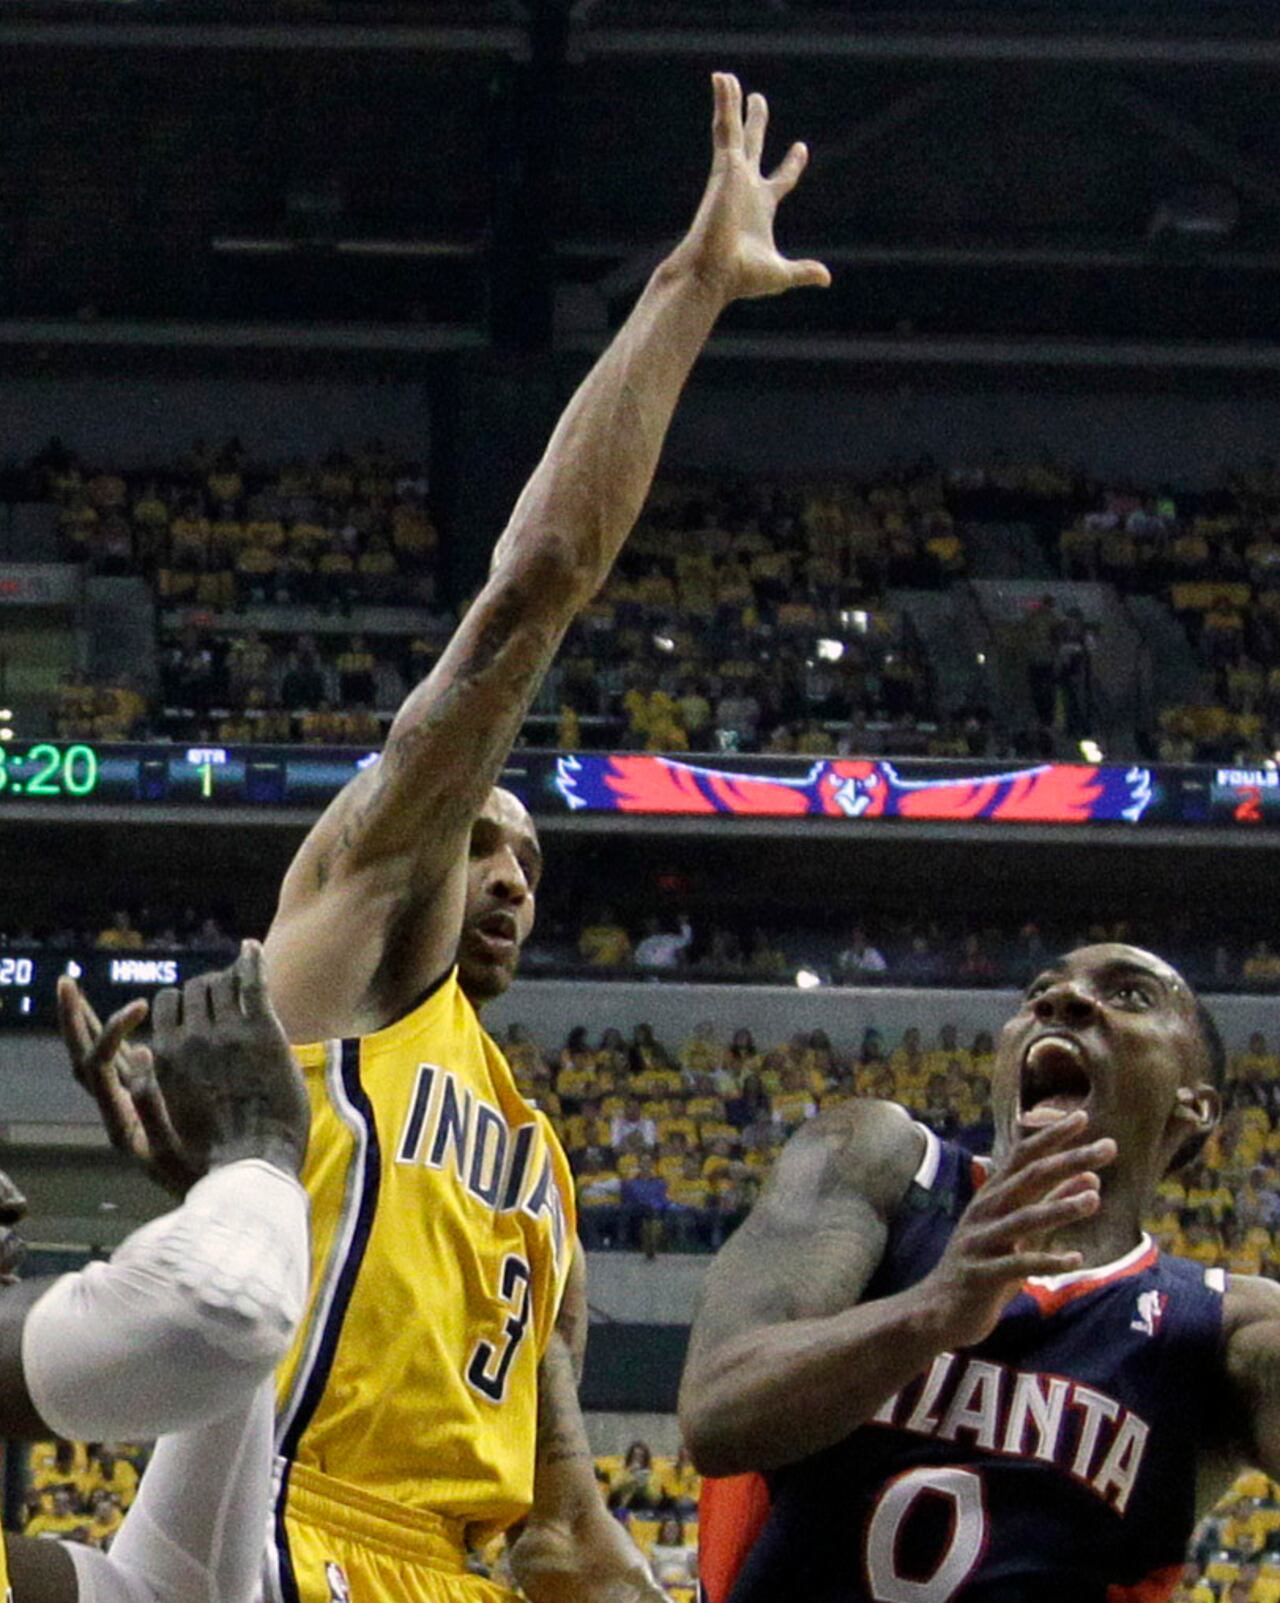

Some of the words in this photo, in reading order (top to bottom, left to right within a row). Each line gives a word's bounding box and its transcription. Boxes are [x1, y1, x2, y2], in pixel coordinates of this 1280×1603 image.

[197, 764, 212, 798] 1
[1217, 769, 1280, 786] FOULS
[1233, 785, 1265, 822] 2
[110, 960, 178, 984] HAWKS
[395, 1062, 568, 1270] INDIA
[465, 1252, 532, 1404] 3
[871, 1351, 1151, 1515] LANTA
